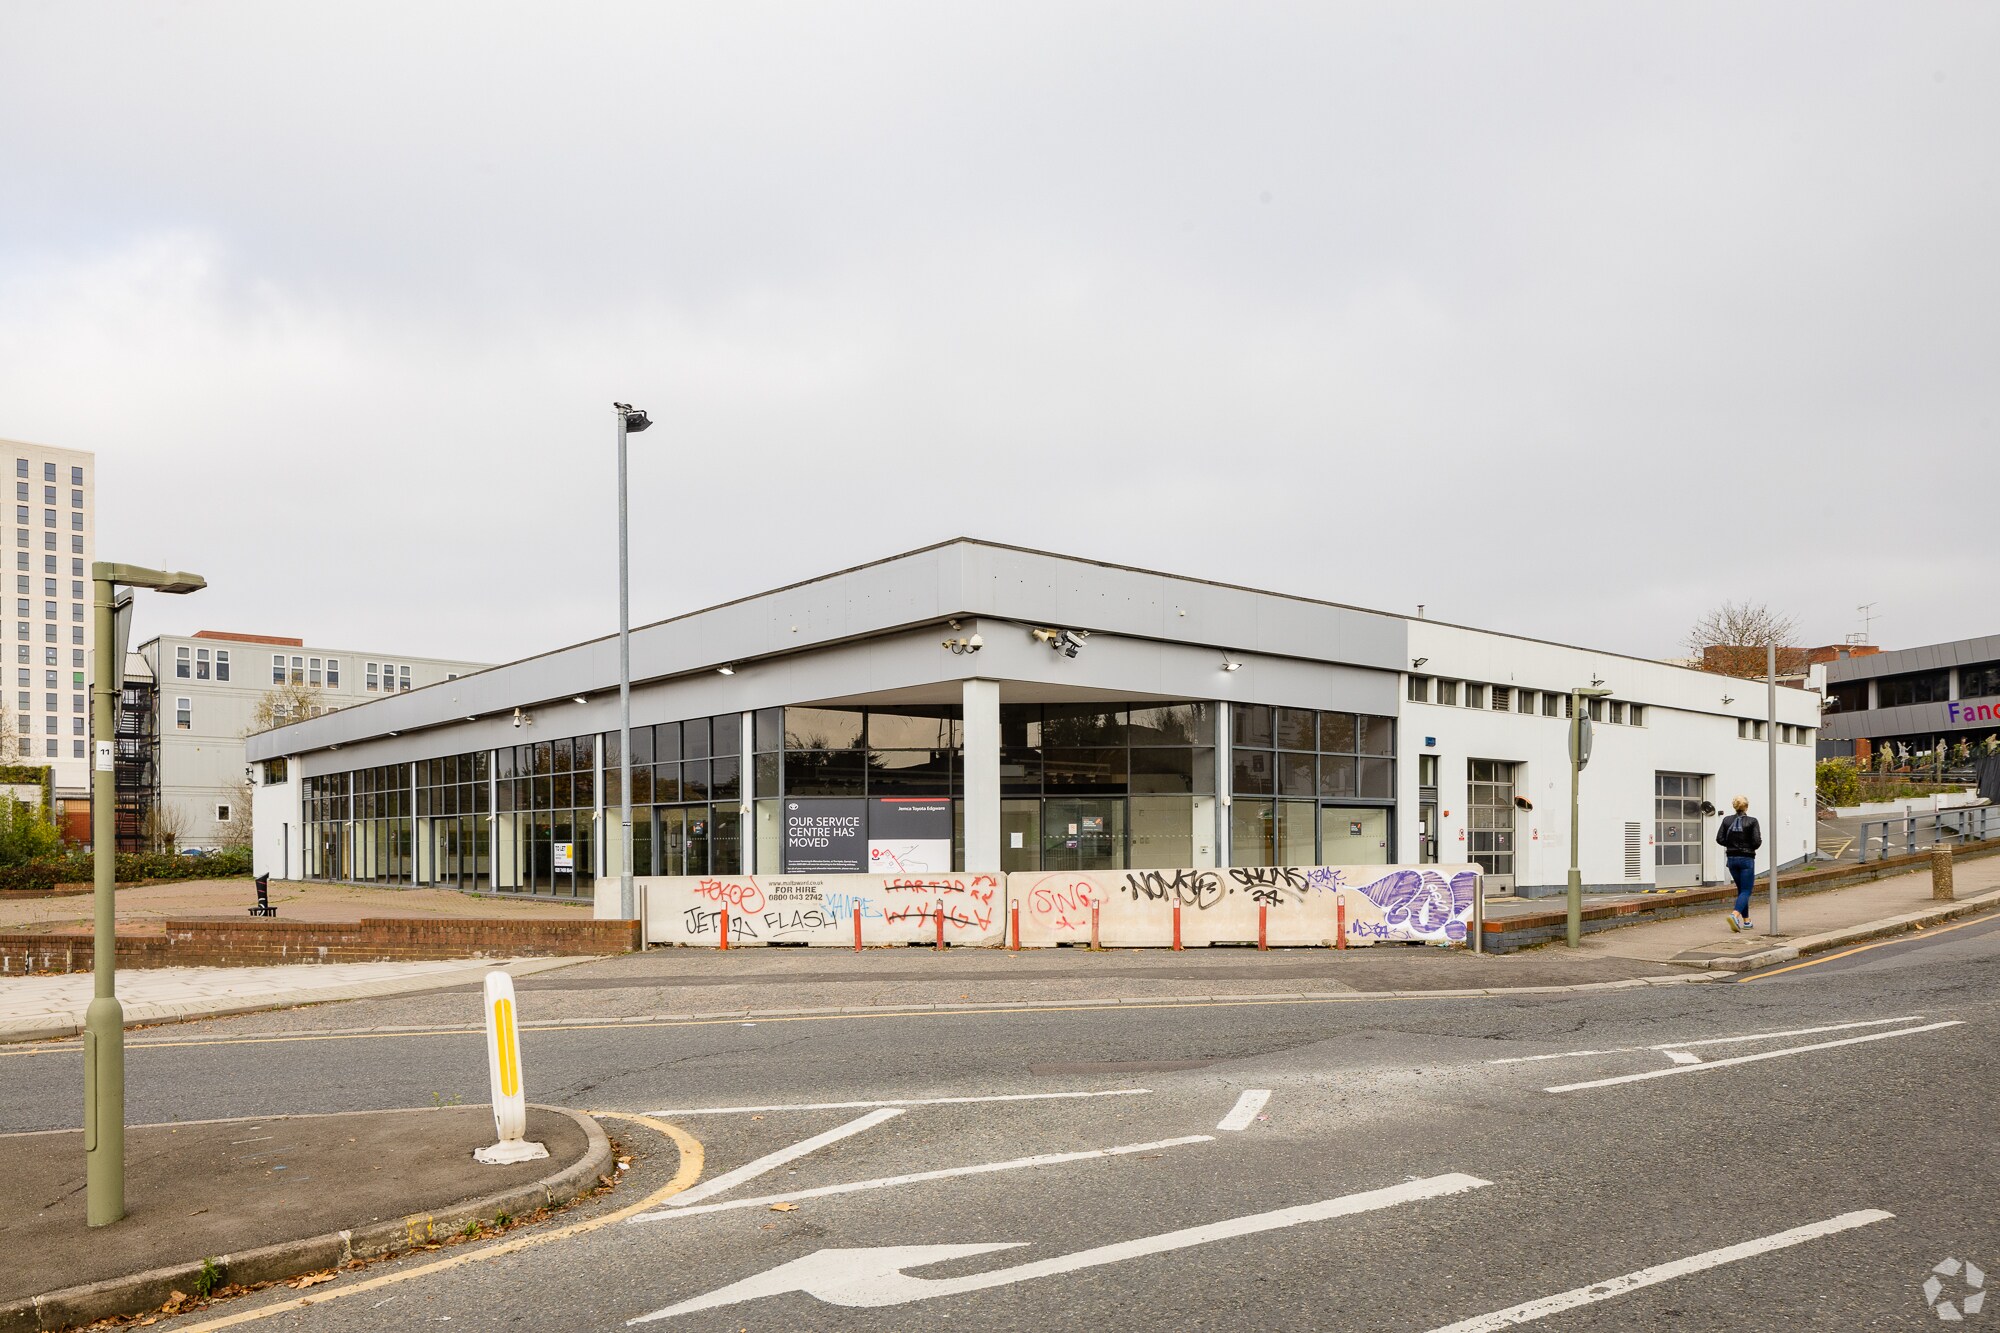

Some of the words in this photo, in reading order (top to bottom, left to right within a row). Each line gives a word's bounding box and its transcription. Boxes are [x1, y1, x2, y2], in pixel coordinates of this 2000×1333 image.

[788, 816, 814, 827] OUR
[816, 816, 860, 827] SERVICE
[788, 827, 831, 837] CENTRE
[833, 827, 855, 837] HAS
[789, 837, 829, 848] MOVED
[804, 893, 823, 901] 2742
